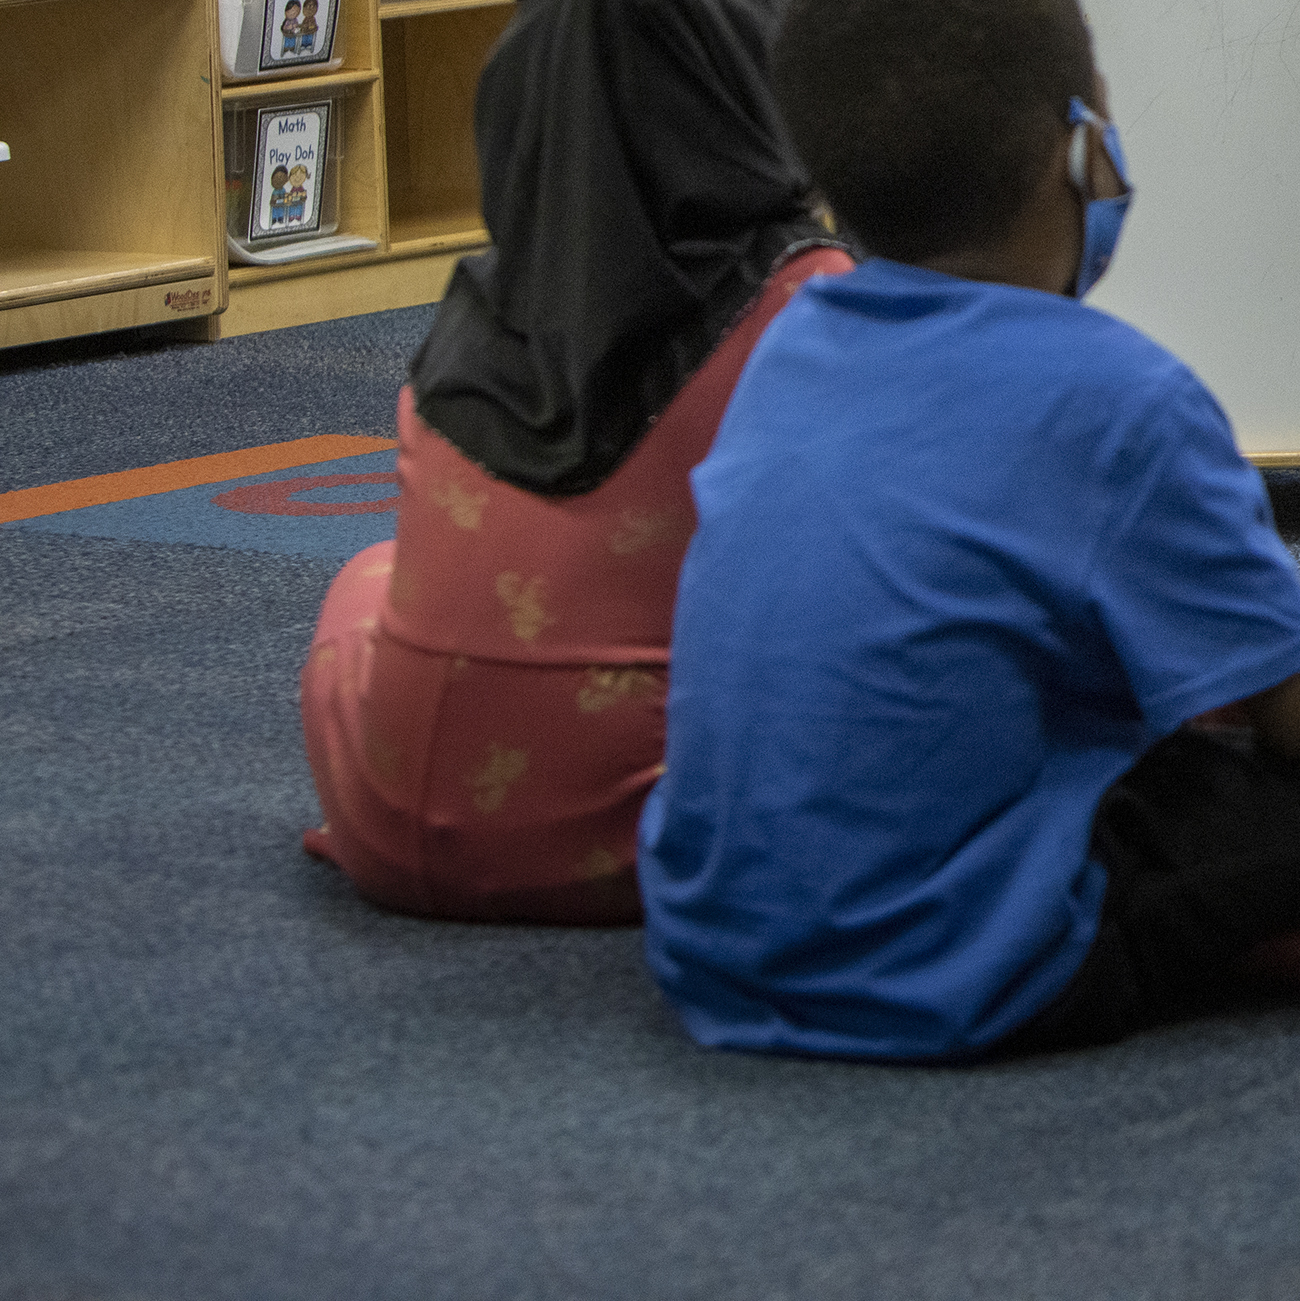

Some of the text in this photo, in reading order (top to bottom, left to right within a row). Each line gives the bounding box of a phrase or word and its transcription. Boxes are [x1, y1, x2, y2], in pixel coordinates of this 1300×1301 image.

[278, 116, 306, 135] Math
[269, 143, 315, 166] Play Doh
